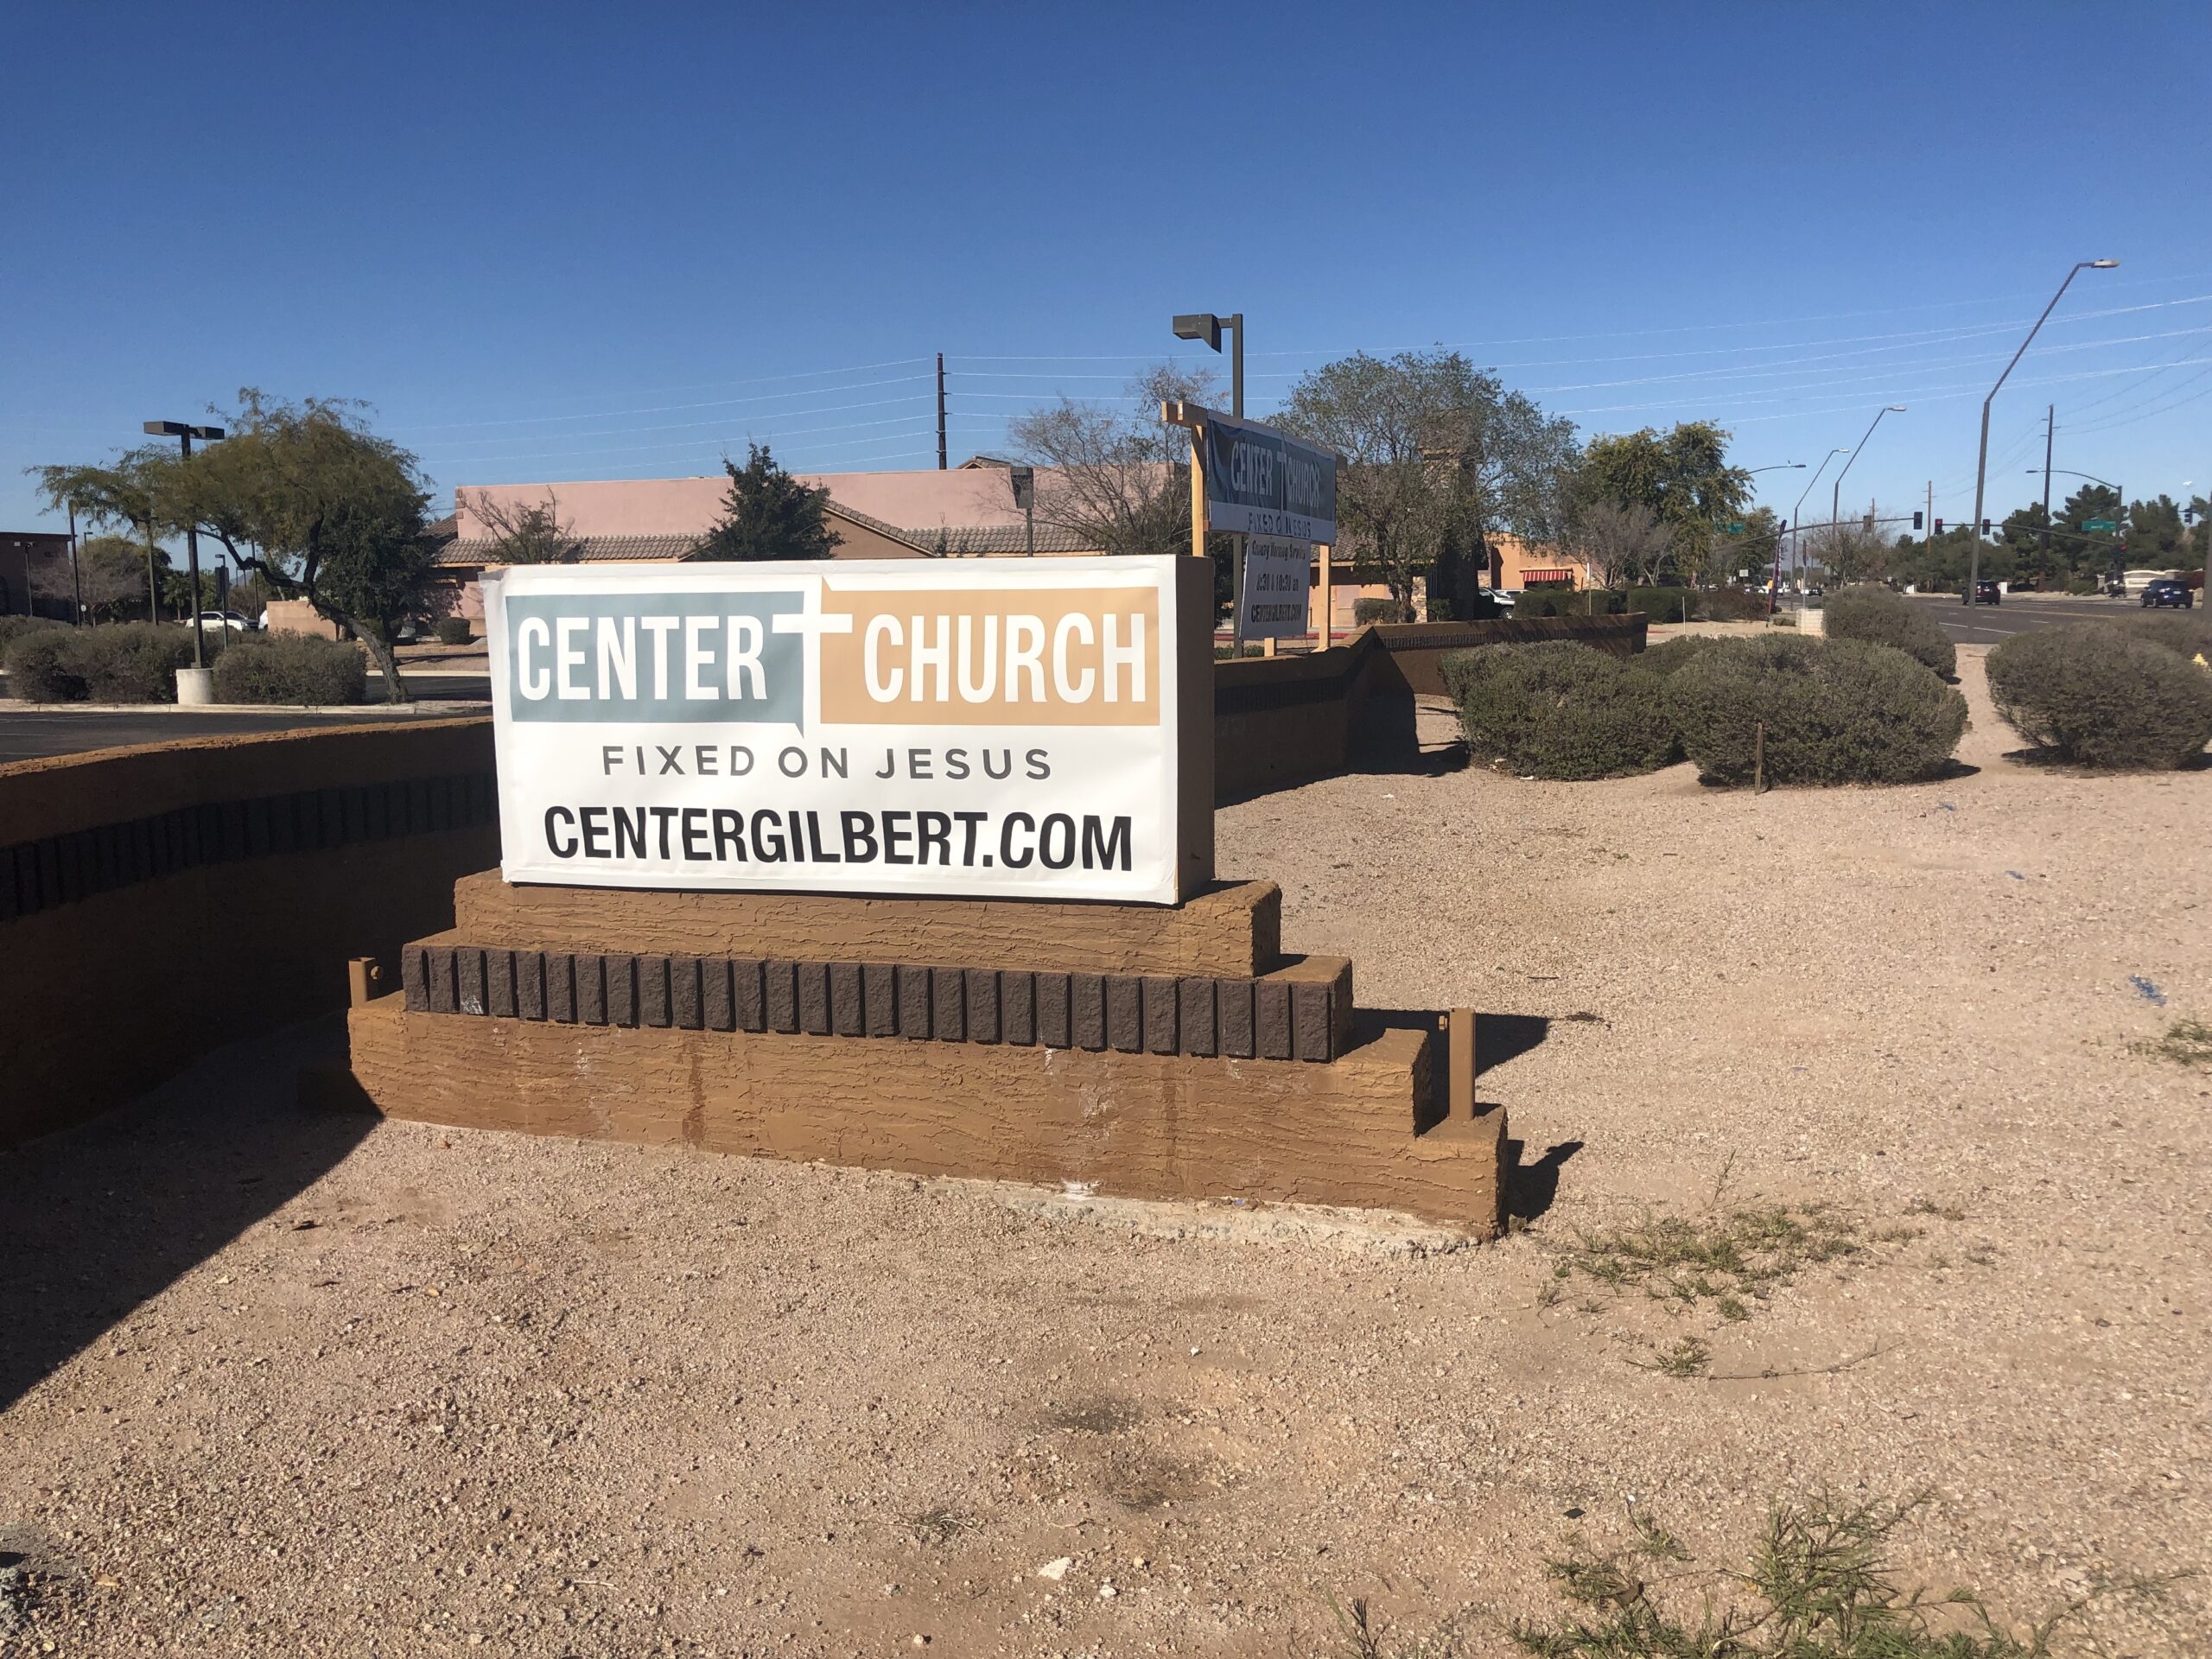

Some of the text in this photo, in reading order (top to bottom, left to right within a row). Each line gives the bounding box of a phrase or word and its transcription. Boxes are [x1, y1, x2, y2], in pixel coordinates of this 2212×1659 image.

[1230, 441, 1320, 509] CENTER CHURCH
[1248, 512, 1274, 533] FIXED
[518, 613, 1146, 703] CENTER CHURCH
[602, 746, 1051, 780] FIXED ON JESUS
[544, 805, 1132, 872] CENTERGILBERT.COM
